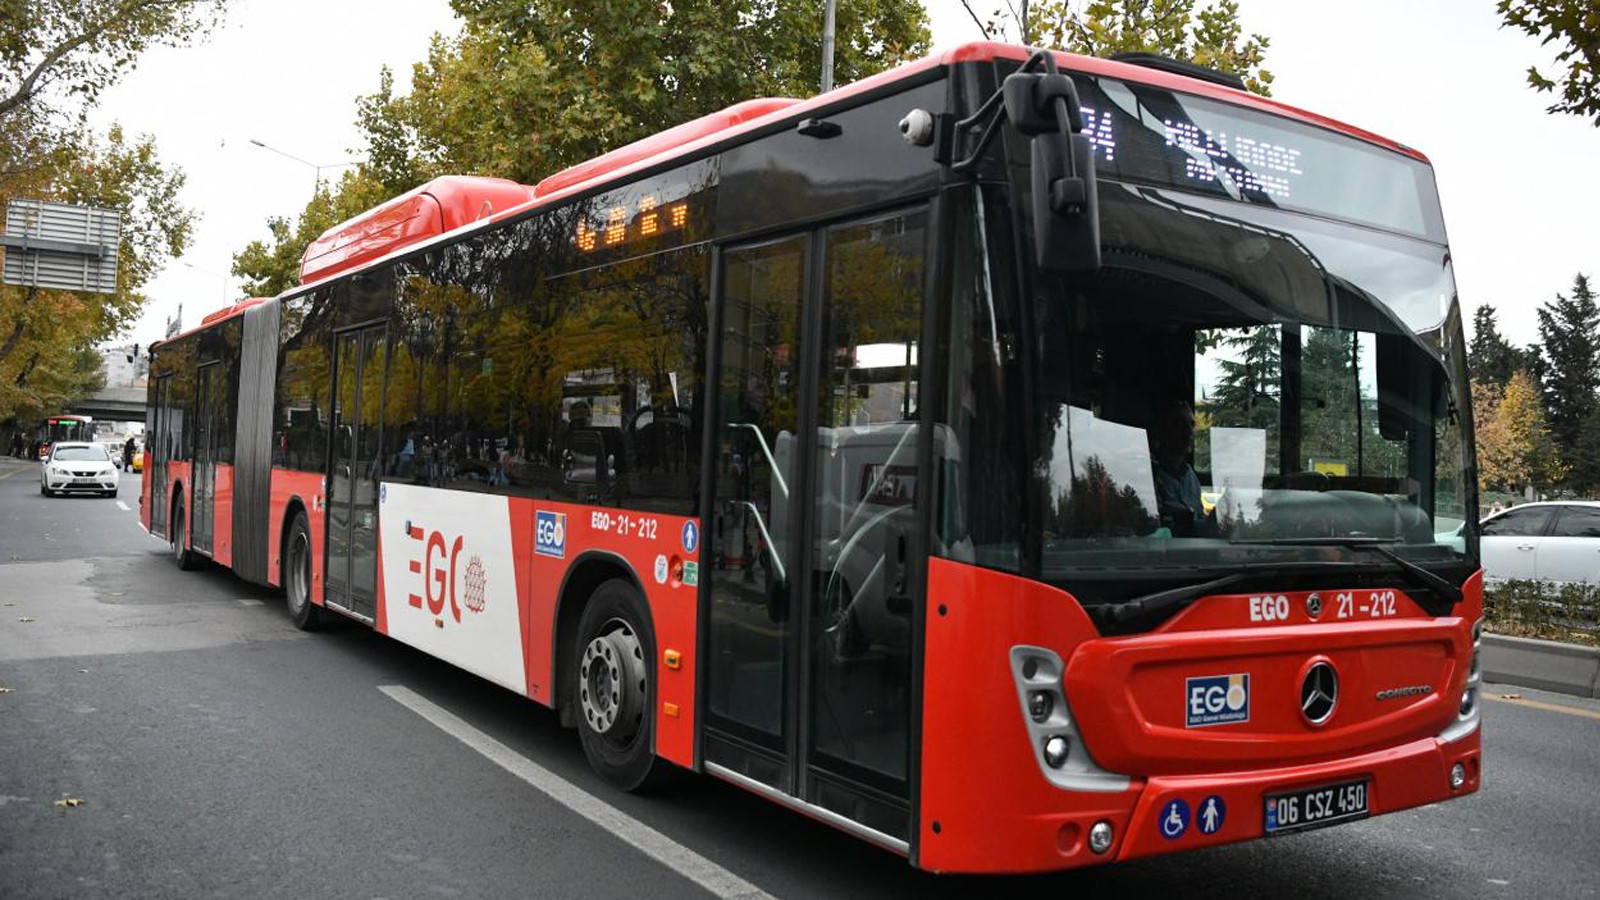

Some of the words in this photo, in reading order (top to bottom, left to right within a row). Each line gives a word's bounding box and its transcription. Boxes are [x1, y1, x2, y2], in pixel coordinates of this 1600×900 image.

[536, 519, 564, 547] EGO
[1249, 595, 1290, 622] EGO
[1190, 684, 1246, 715] EGO
[1278, 797, 1299, 825] 06
[1305, 790, 1334, 820] CSZ
[1338, 784, 1364, 813] 450
